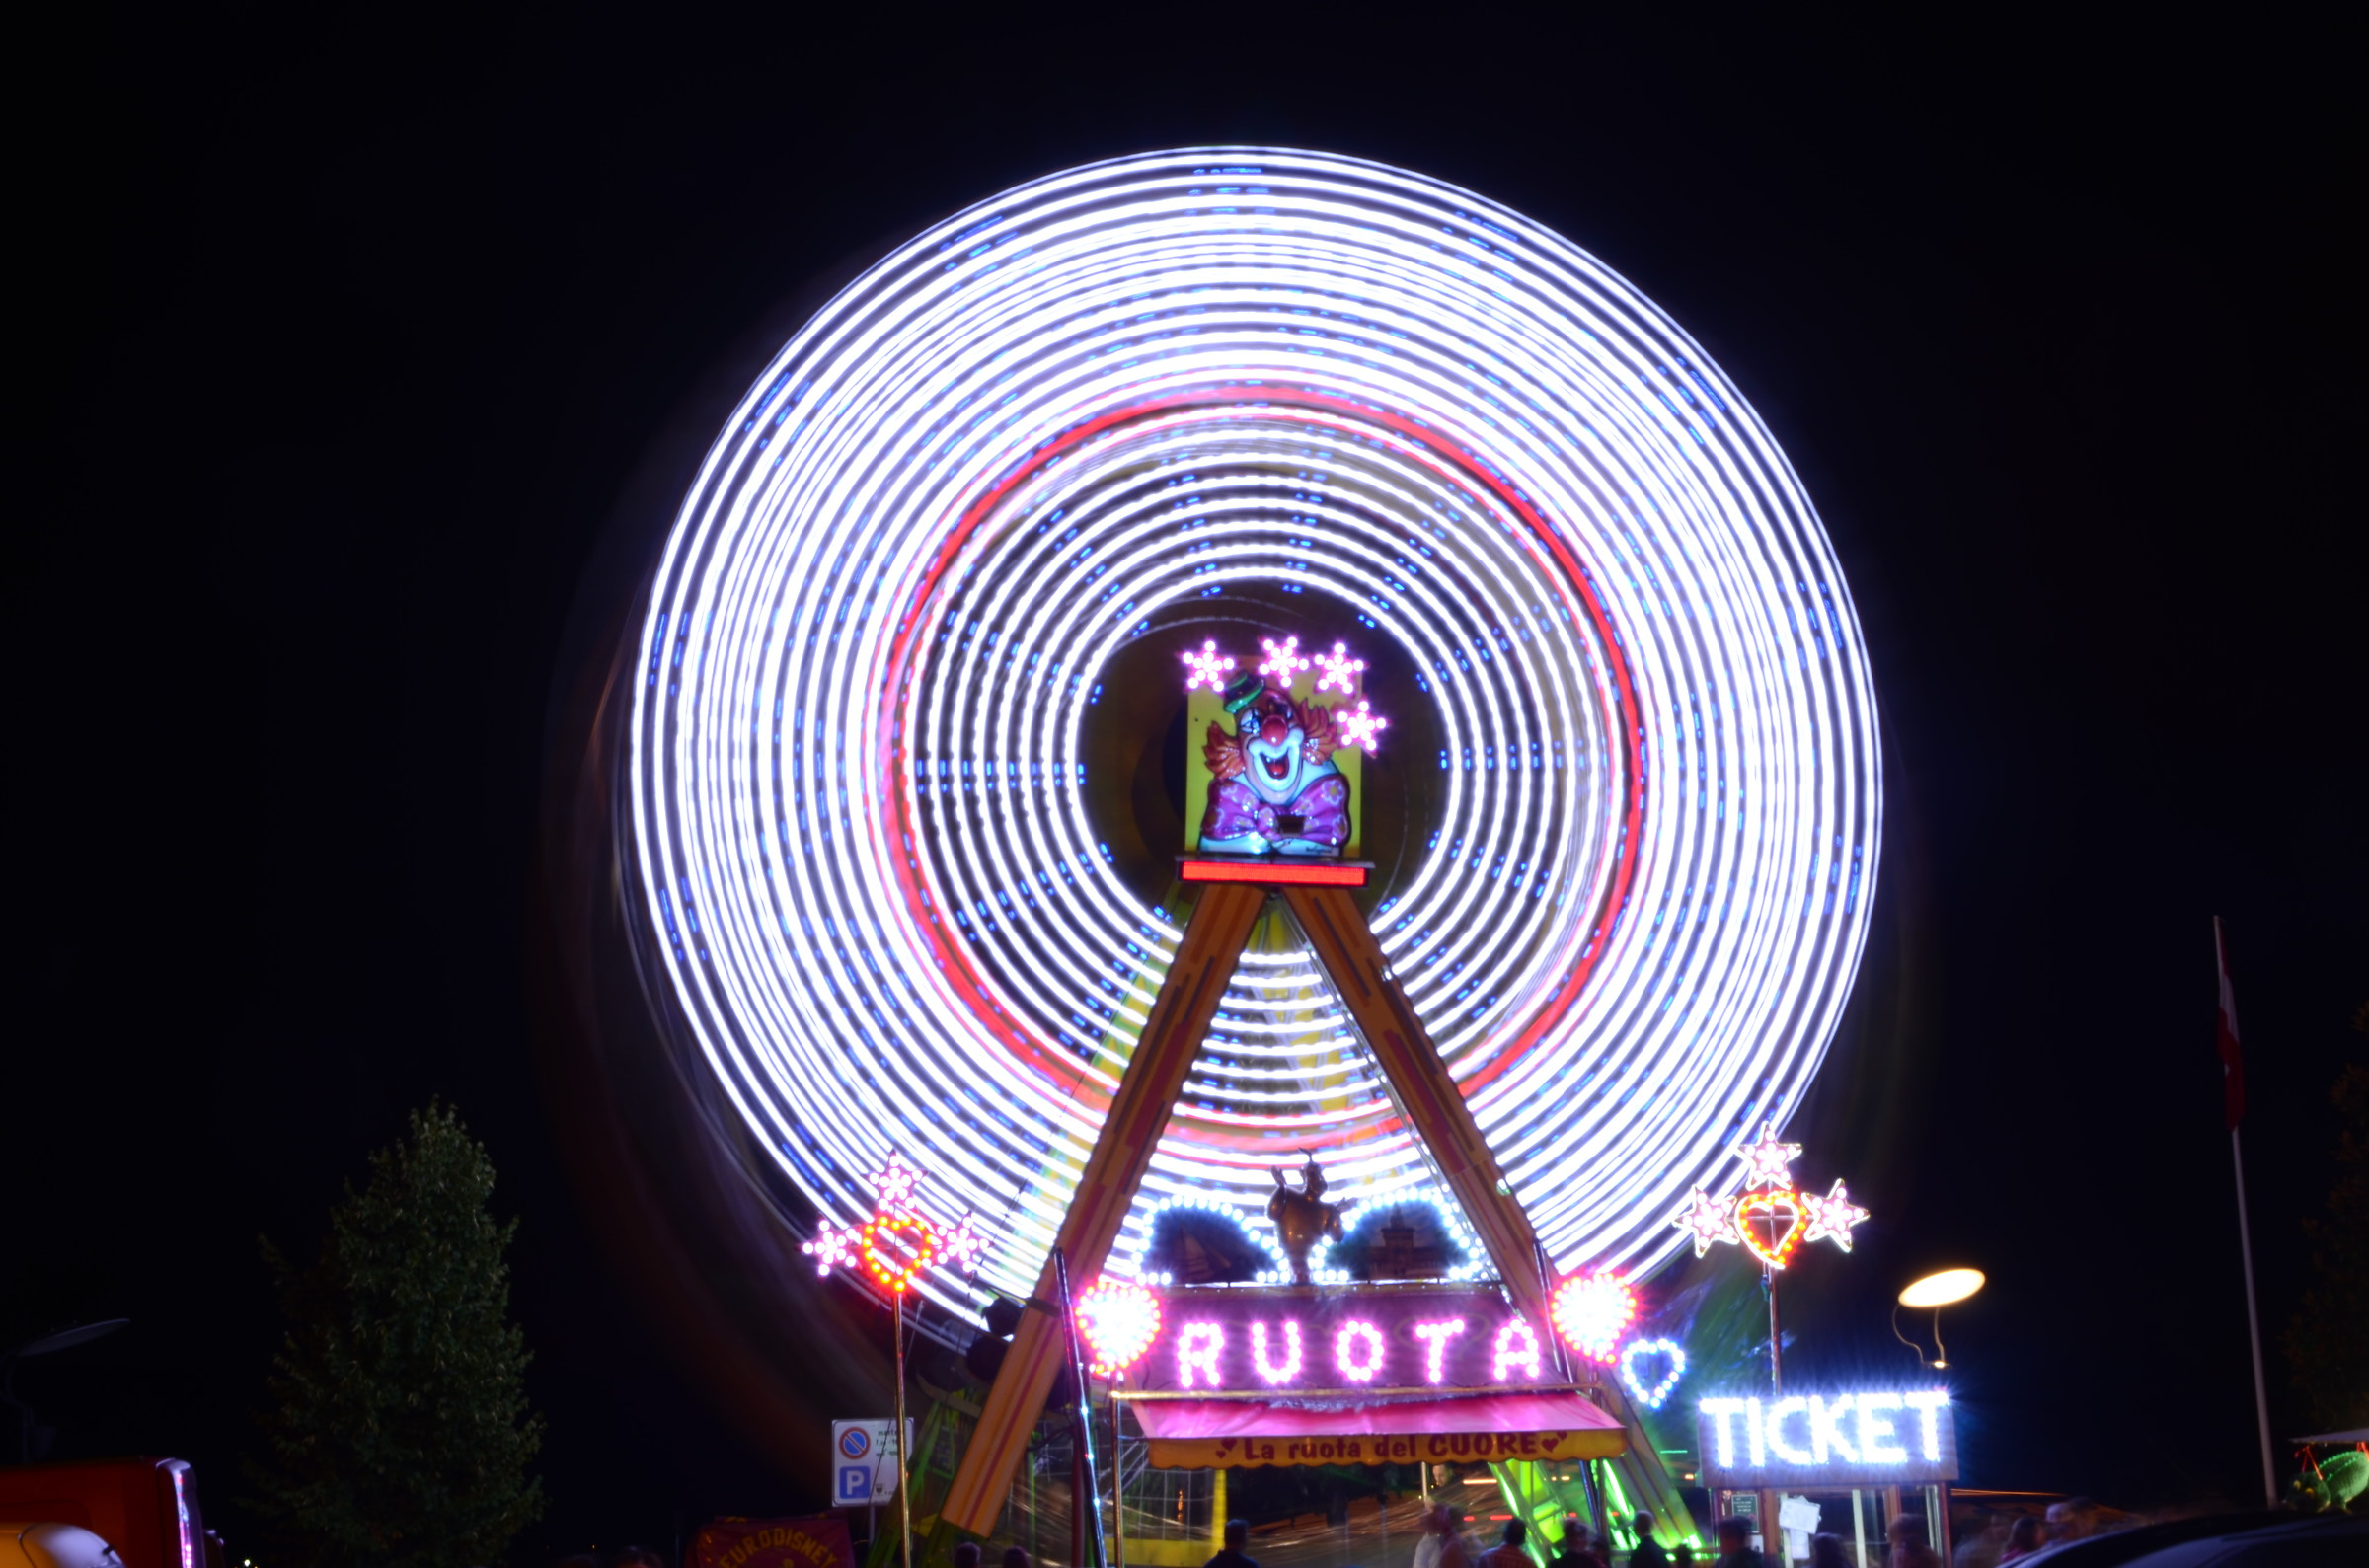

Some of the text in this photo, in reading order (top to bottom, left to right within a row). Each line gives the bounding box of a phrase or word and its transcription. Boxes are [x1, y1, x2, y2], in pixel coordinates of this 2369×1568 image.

[1177, 1318, 1541, 1388] RUOTA
[1245, 1432, 1537, 1460] La ruota del CUORE
[1698, 1391, 1949, 1468] TICKET
[846, 1470, 865, 1496] P
[719, 1527, 838, 1568] EURODISNEY
